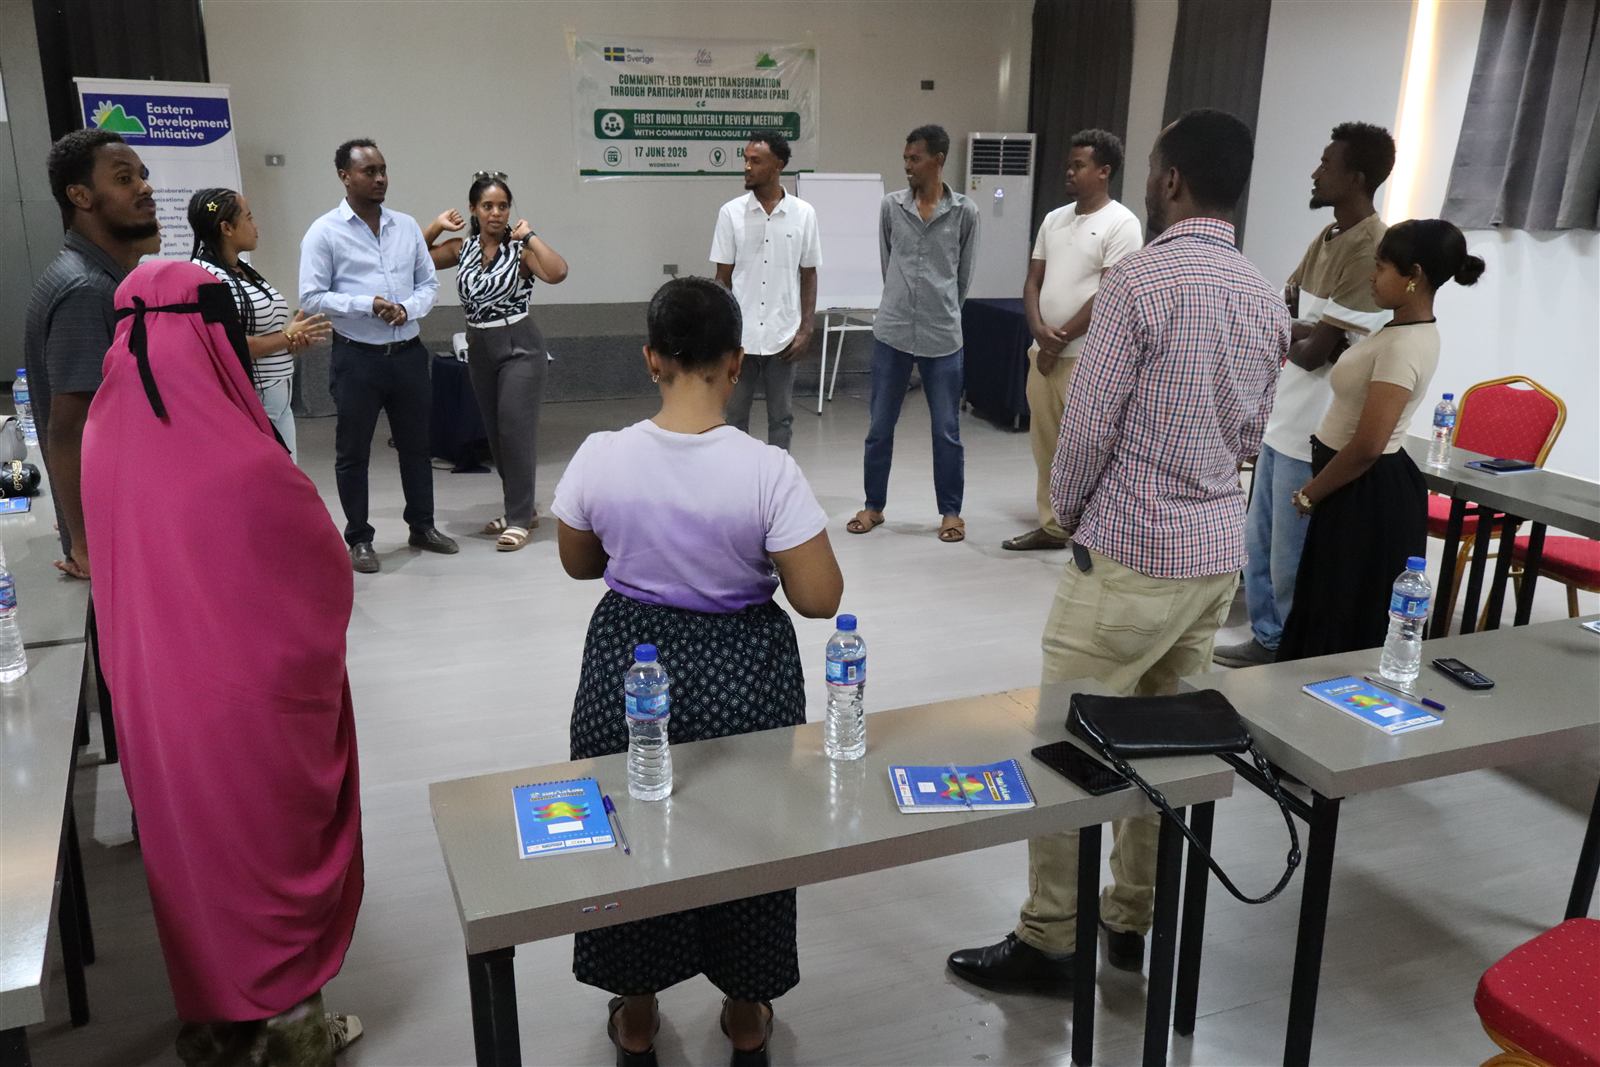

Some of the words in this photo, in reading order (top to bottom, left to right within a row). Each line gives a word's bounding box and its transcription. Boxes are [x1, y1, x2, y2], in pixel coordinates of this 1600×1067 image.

[626, 54, 654, 64] Sverige
[618, 74, 681, 86] COMMUNITY-LED
[682, 75, 717, 87] CONFLICT
[718, 77, 781, 88] TRANSFORMATION
[609, 85, 645, 97] THROUGH
[647, 86, 703, 98] PARTICIPATORY
[704, 87, 731, 99] ACTION
[732, 88, 768, 100] RESEARCH
[146, 102, 193, 115] Eastern
[148, 115, 229, 129] Development
[633, 112, 655, 124] FIRST
[655, 113, 682, 125] ROUND
[682, 113, 723, 126] QUARTERLY
[724, 114, 751, 126] REVIEW
[752, 115, 784, 126] MEETING
[150, 129, 205, 140] Initiative
[634, 128, 654, 137] WITH
[655, 128, 704, 138] COMMUNITY
[704, 129, 741, 138] DIALOGUE
[634, 146, 644, 158] 17
[645, 146, 666, 158] JUNE
[667, 147, 688, 158] 2026
